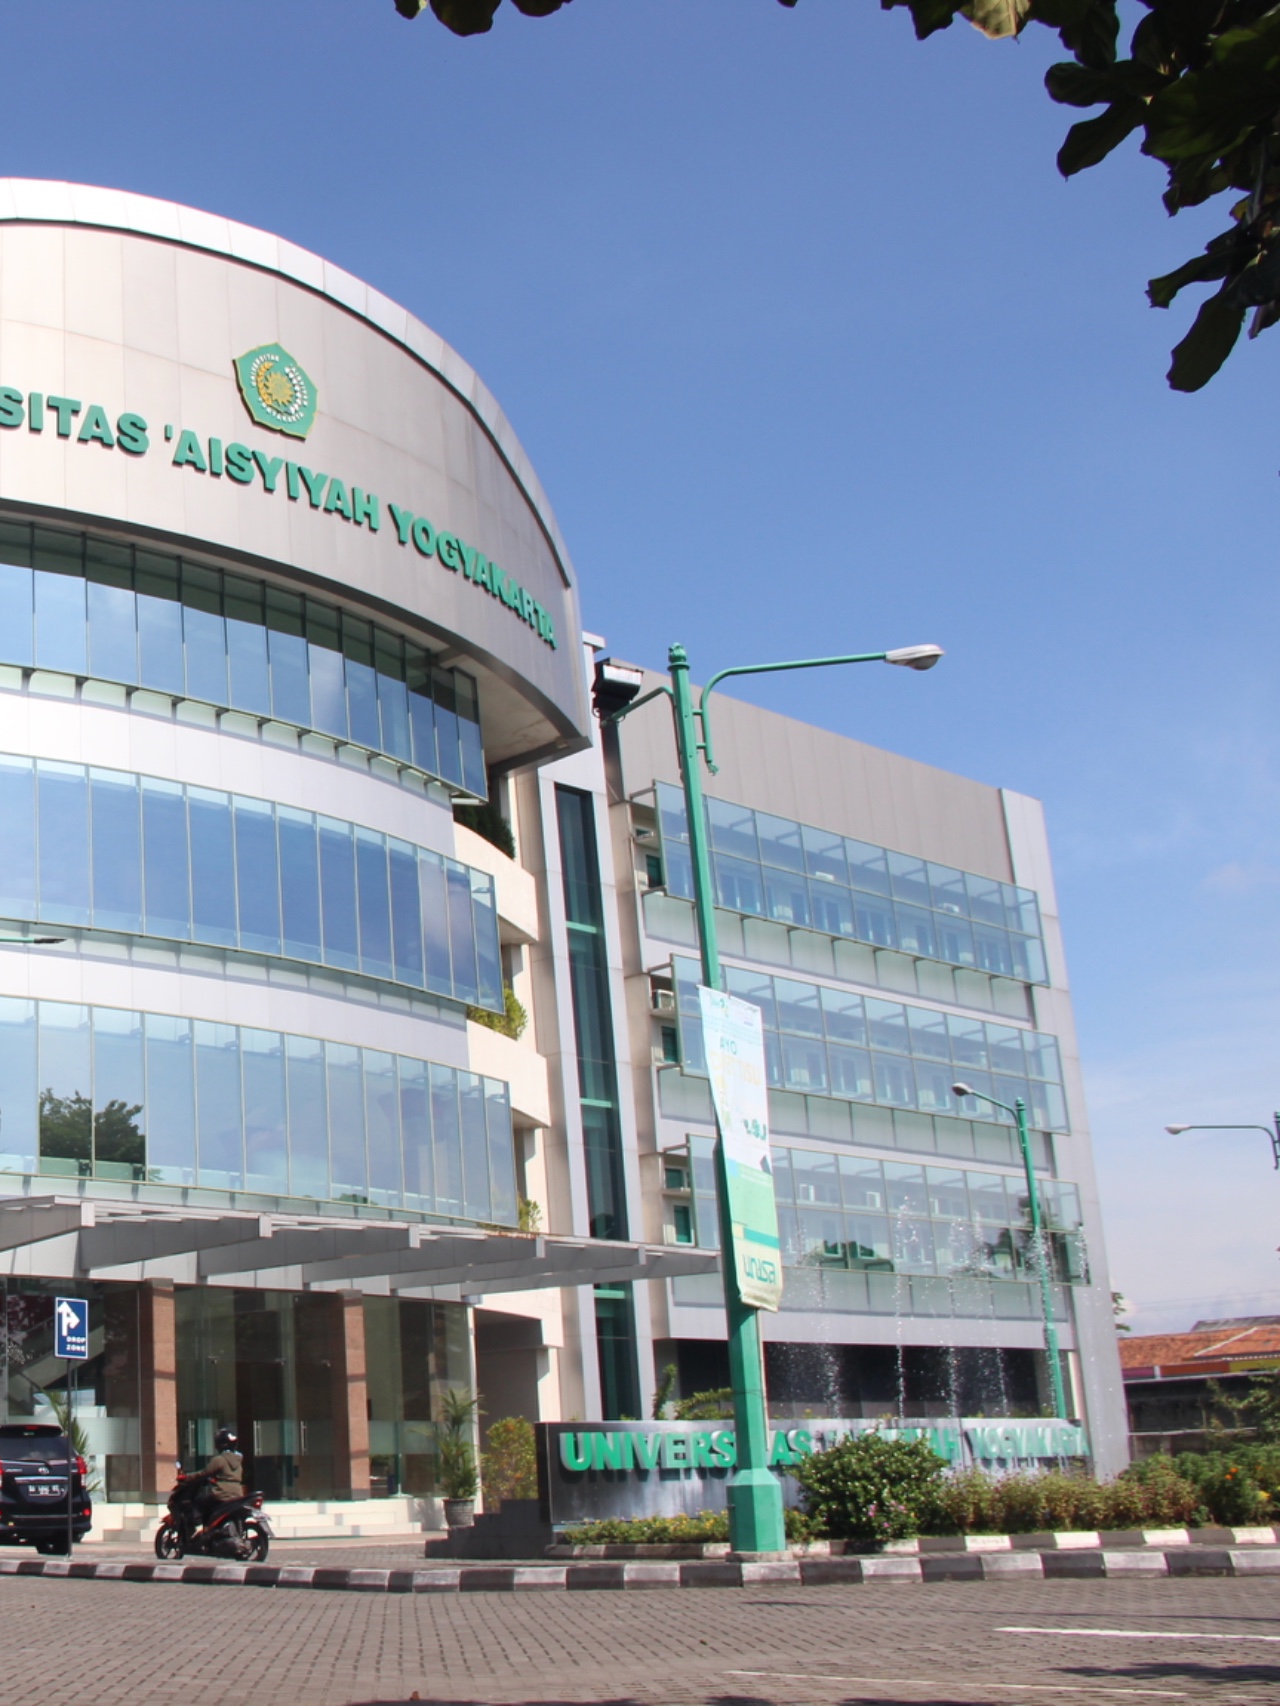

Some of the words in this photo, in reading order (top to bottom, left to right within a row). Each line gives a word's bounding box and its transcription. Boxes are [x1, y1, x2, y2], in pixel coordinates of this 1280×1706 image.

[164, 424, 380, 532] 'AISYIYAH
[388, 503, 558, 650] YOGYAKARTA
[559, 1430, 813, 1471] UNIVERSAS
